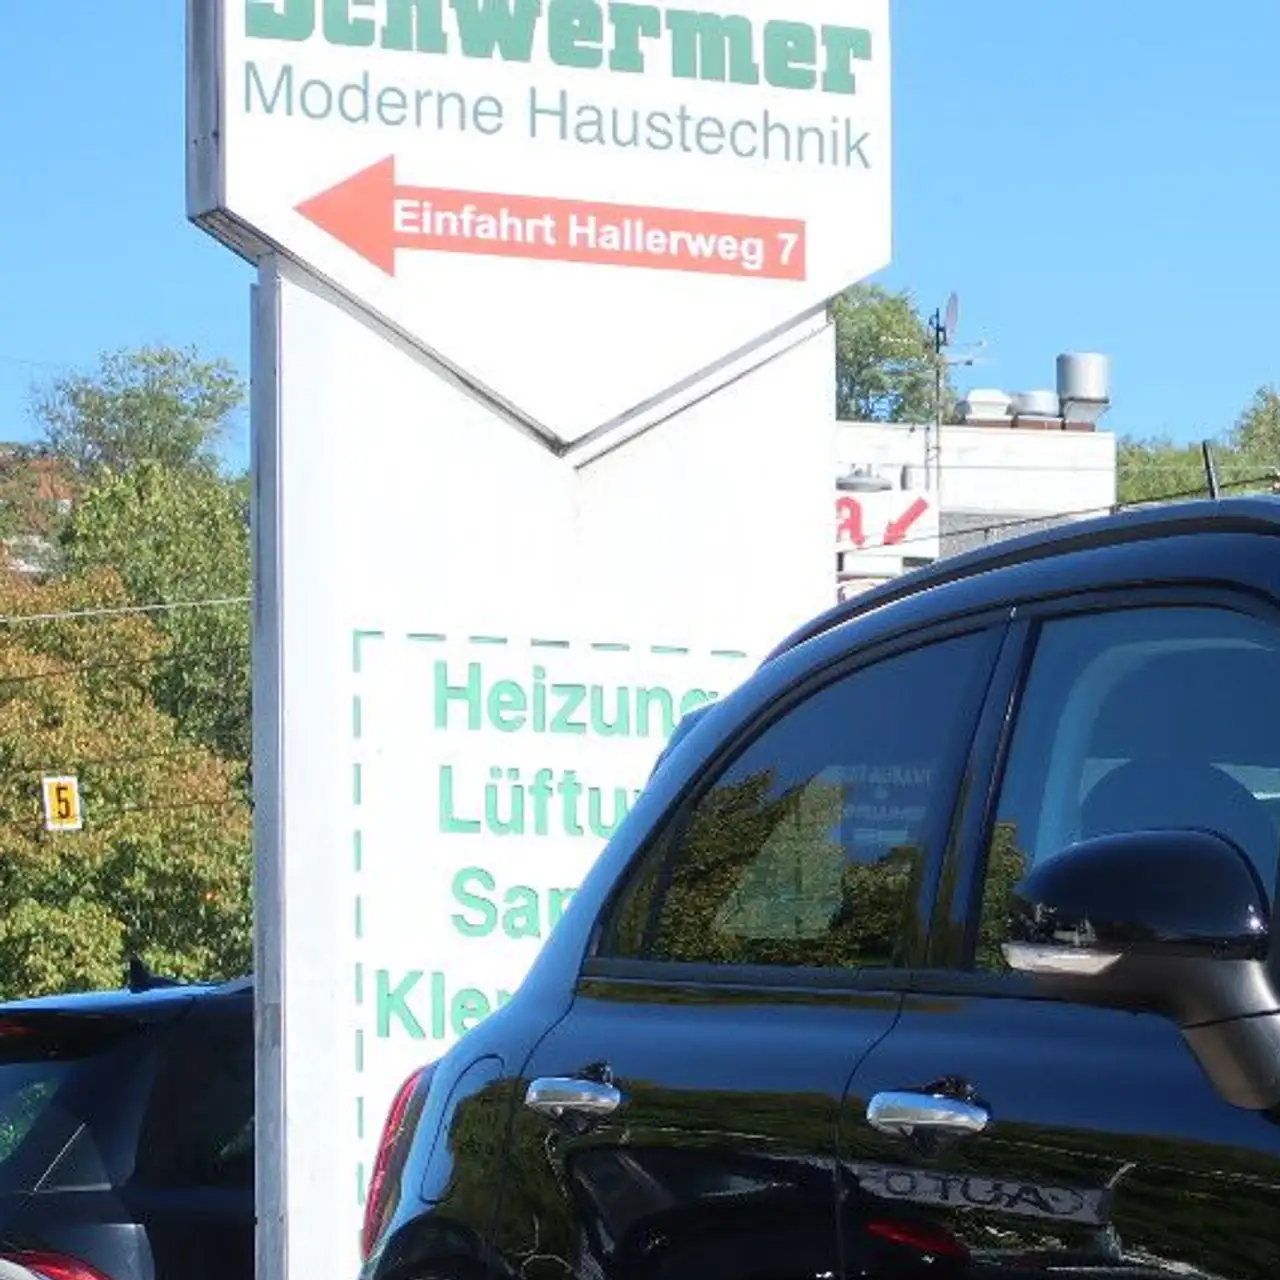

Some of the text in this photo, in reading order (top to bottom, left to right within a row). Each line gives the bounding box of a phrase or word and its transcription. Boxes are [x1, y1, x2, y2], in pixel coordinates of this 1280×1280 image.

[243, 60, 872, 170] Moderne Haustechnik
[392, 197, 800, 270] Einfahrt Hallerweg 7
[54, 785, 71, 820] 5
[438, 764, 641, 839] Lüftu
[375, 968, 513, 1041] Kle
